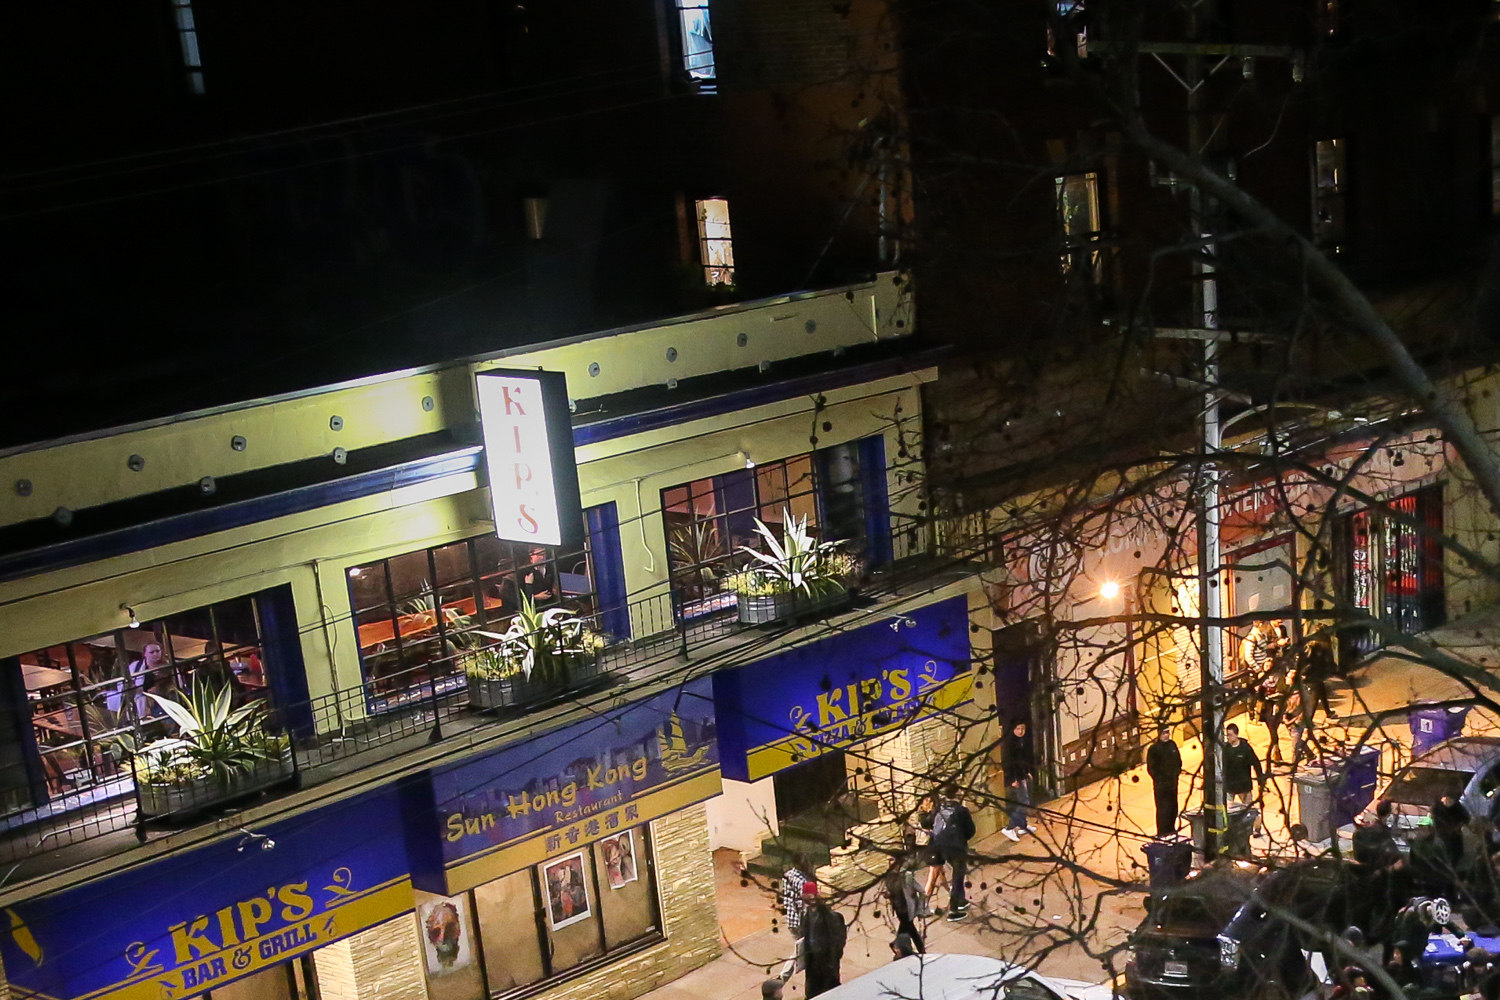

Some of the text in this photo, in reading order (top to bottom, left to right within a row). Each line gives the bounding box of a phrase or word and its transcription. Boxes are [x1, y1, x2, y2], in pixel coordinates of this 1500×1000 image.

[815, 668, 912, 727] KIP'S
[446, 756, 648, 843] Sun Hong Kong
[554, 790, 623, 824] Restaurant
[168, 880, 314, 966] KIP'S
[182, 923, 317, 990] BAR & GRILL
